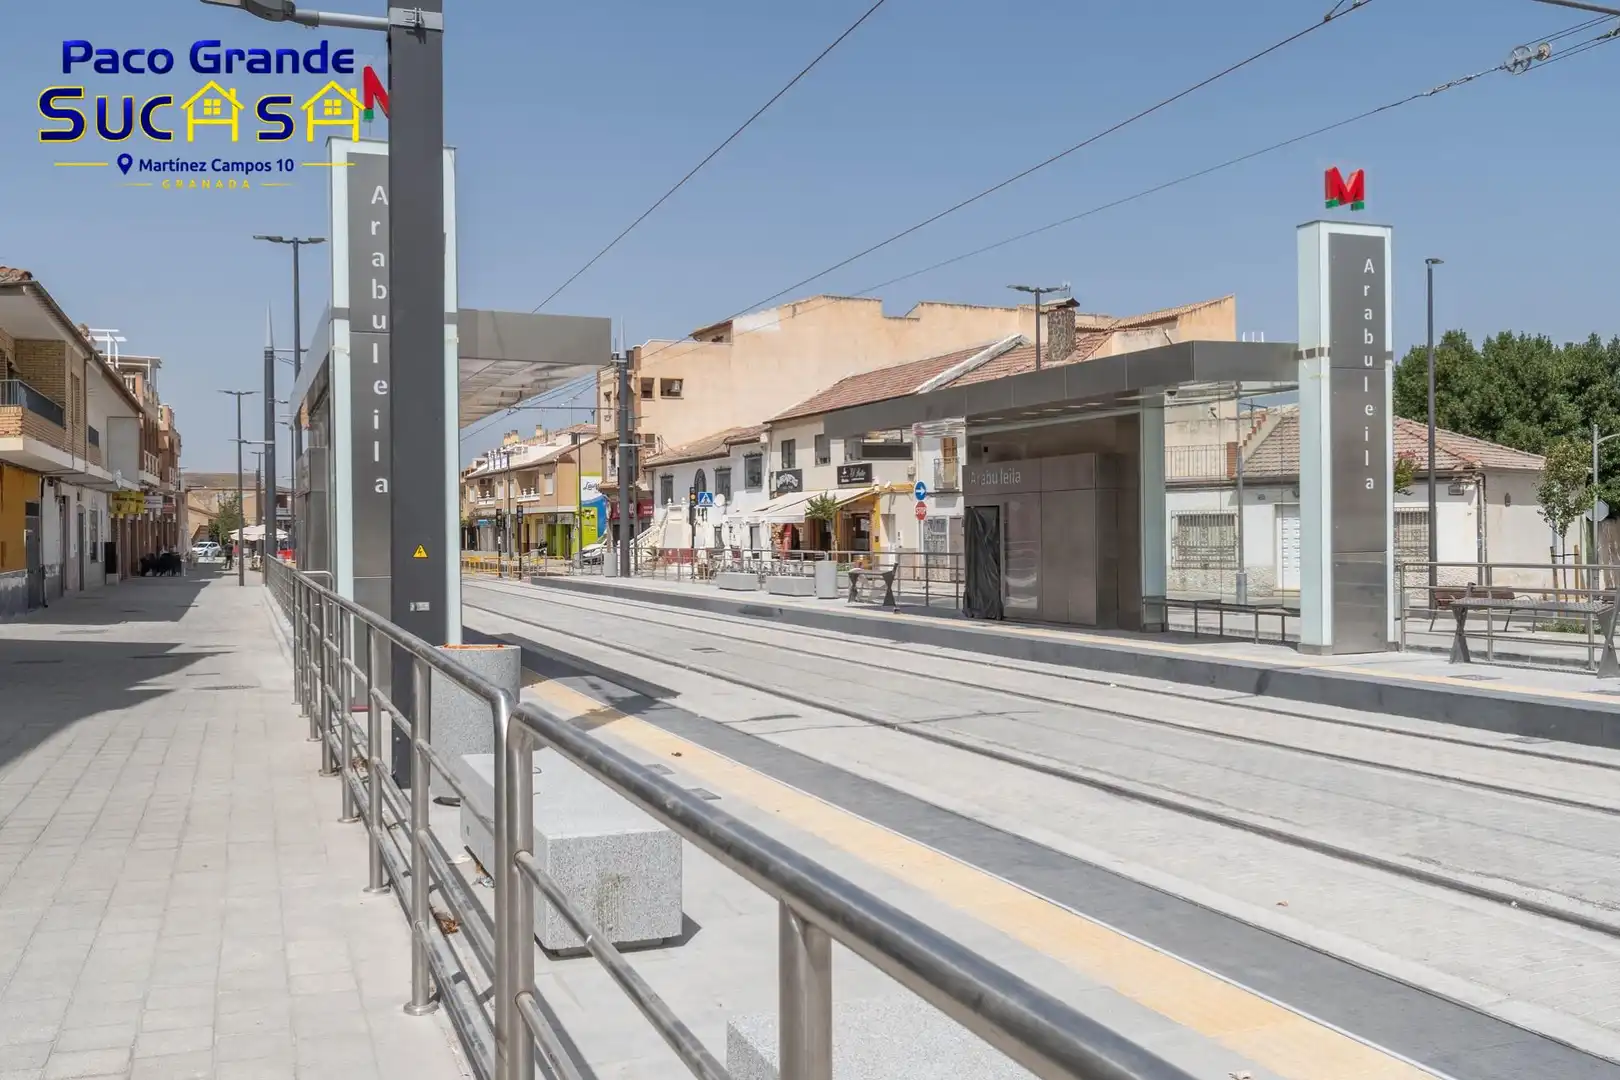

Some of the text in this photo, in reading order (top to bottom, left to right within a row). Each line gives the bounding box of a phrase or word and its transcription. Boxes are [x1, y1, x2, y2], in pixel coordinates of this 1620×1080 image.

[1324, 166, 1365, 211] M
[371, 185, 389, 493] Arabuleila
[1363, 258, 1375, 490] Arabuleila
